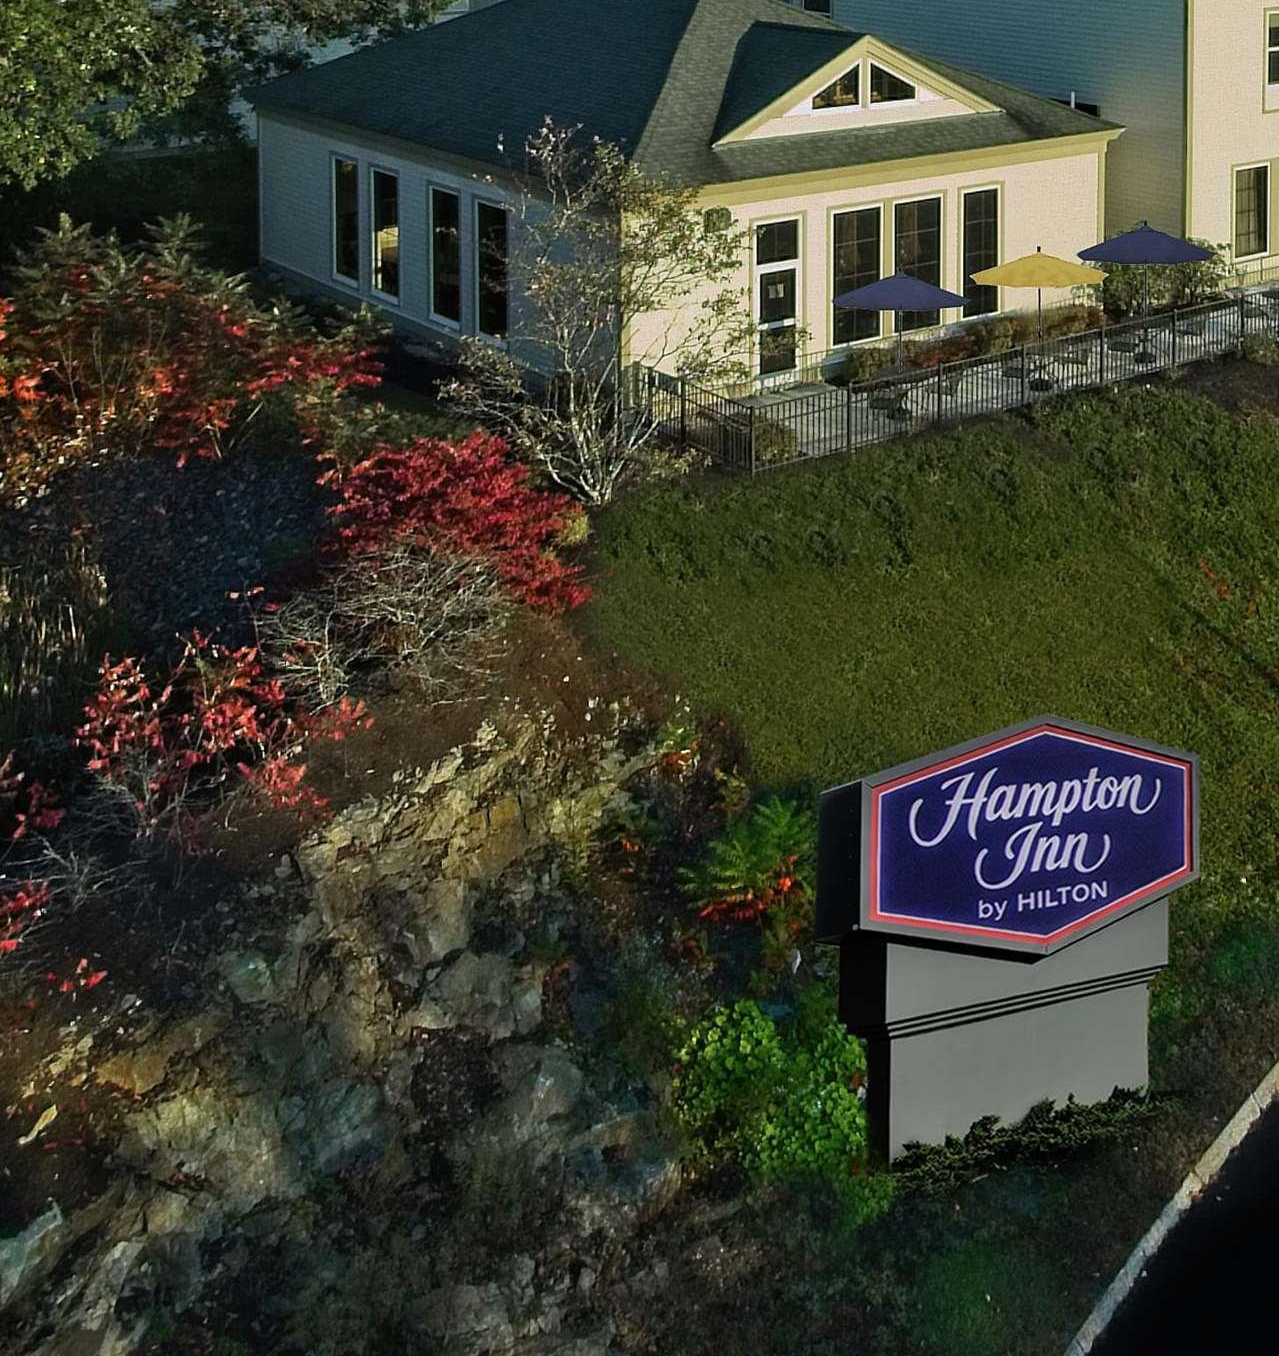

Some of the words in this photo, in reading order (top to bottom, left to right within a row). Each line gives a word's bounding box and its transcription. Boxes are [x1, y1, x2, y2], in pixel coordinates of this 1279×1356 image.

[909, 767, 1161, 847] Hampton
[974, 821, 1111, 890] Inn
[978, 899, 1008, 920] by
[1017, 880, 1108, 912] HILTON
